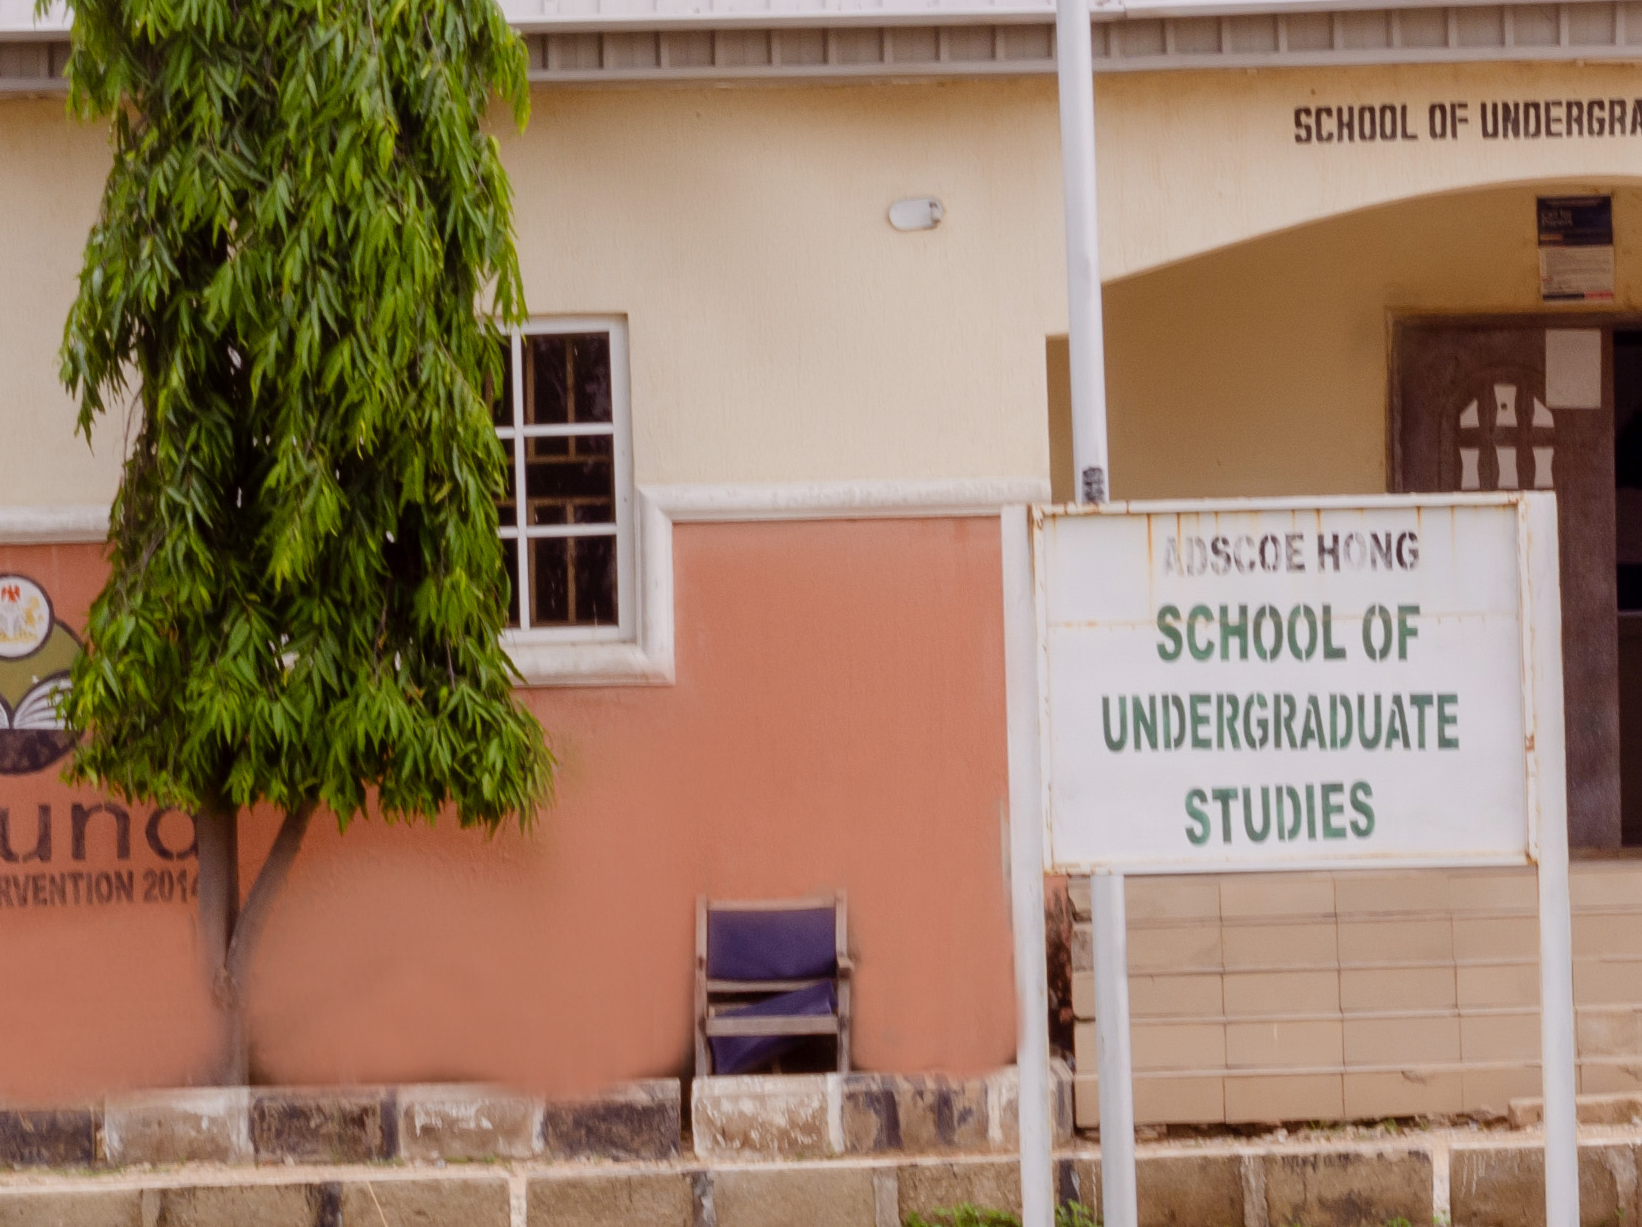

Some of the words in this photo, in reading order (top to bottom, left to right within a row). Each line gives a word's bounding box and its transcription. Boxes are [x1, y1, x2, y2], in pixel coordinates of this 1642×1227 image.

[1293, 103, 1419, 143] SCHOOL
[1429, 101, 1469, 140] OF
[1164, 532, 1306, 576] ADSCOE
[1317, 530, 1420, 572] HONG
[1156, 604, 1348, 662] SCHOOL
[1362, 604, 1421, 662] OF
[1101, 692, 1461, 753] UNDERGRADUATE
[1184, 780, 1376, 846] STUDIES
